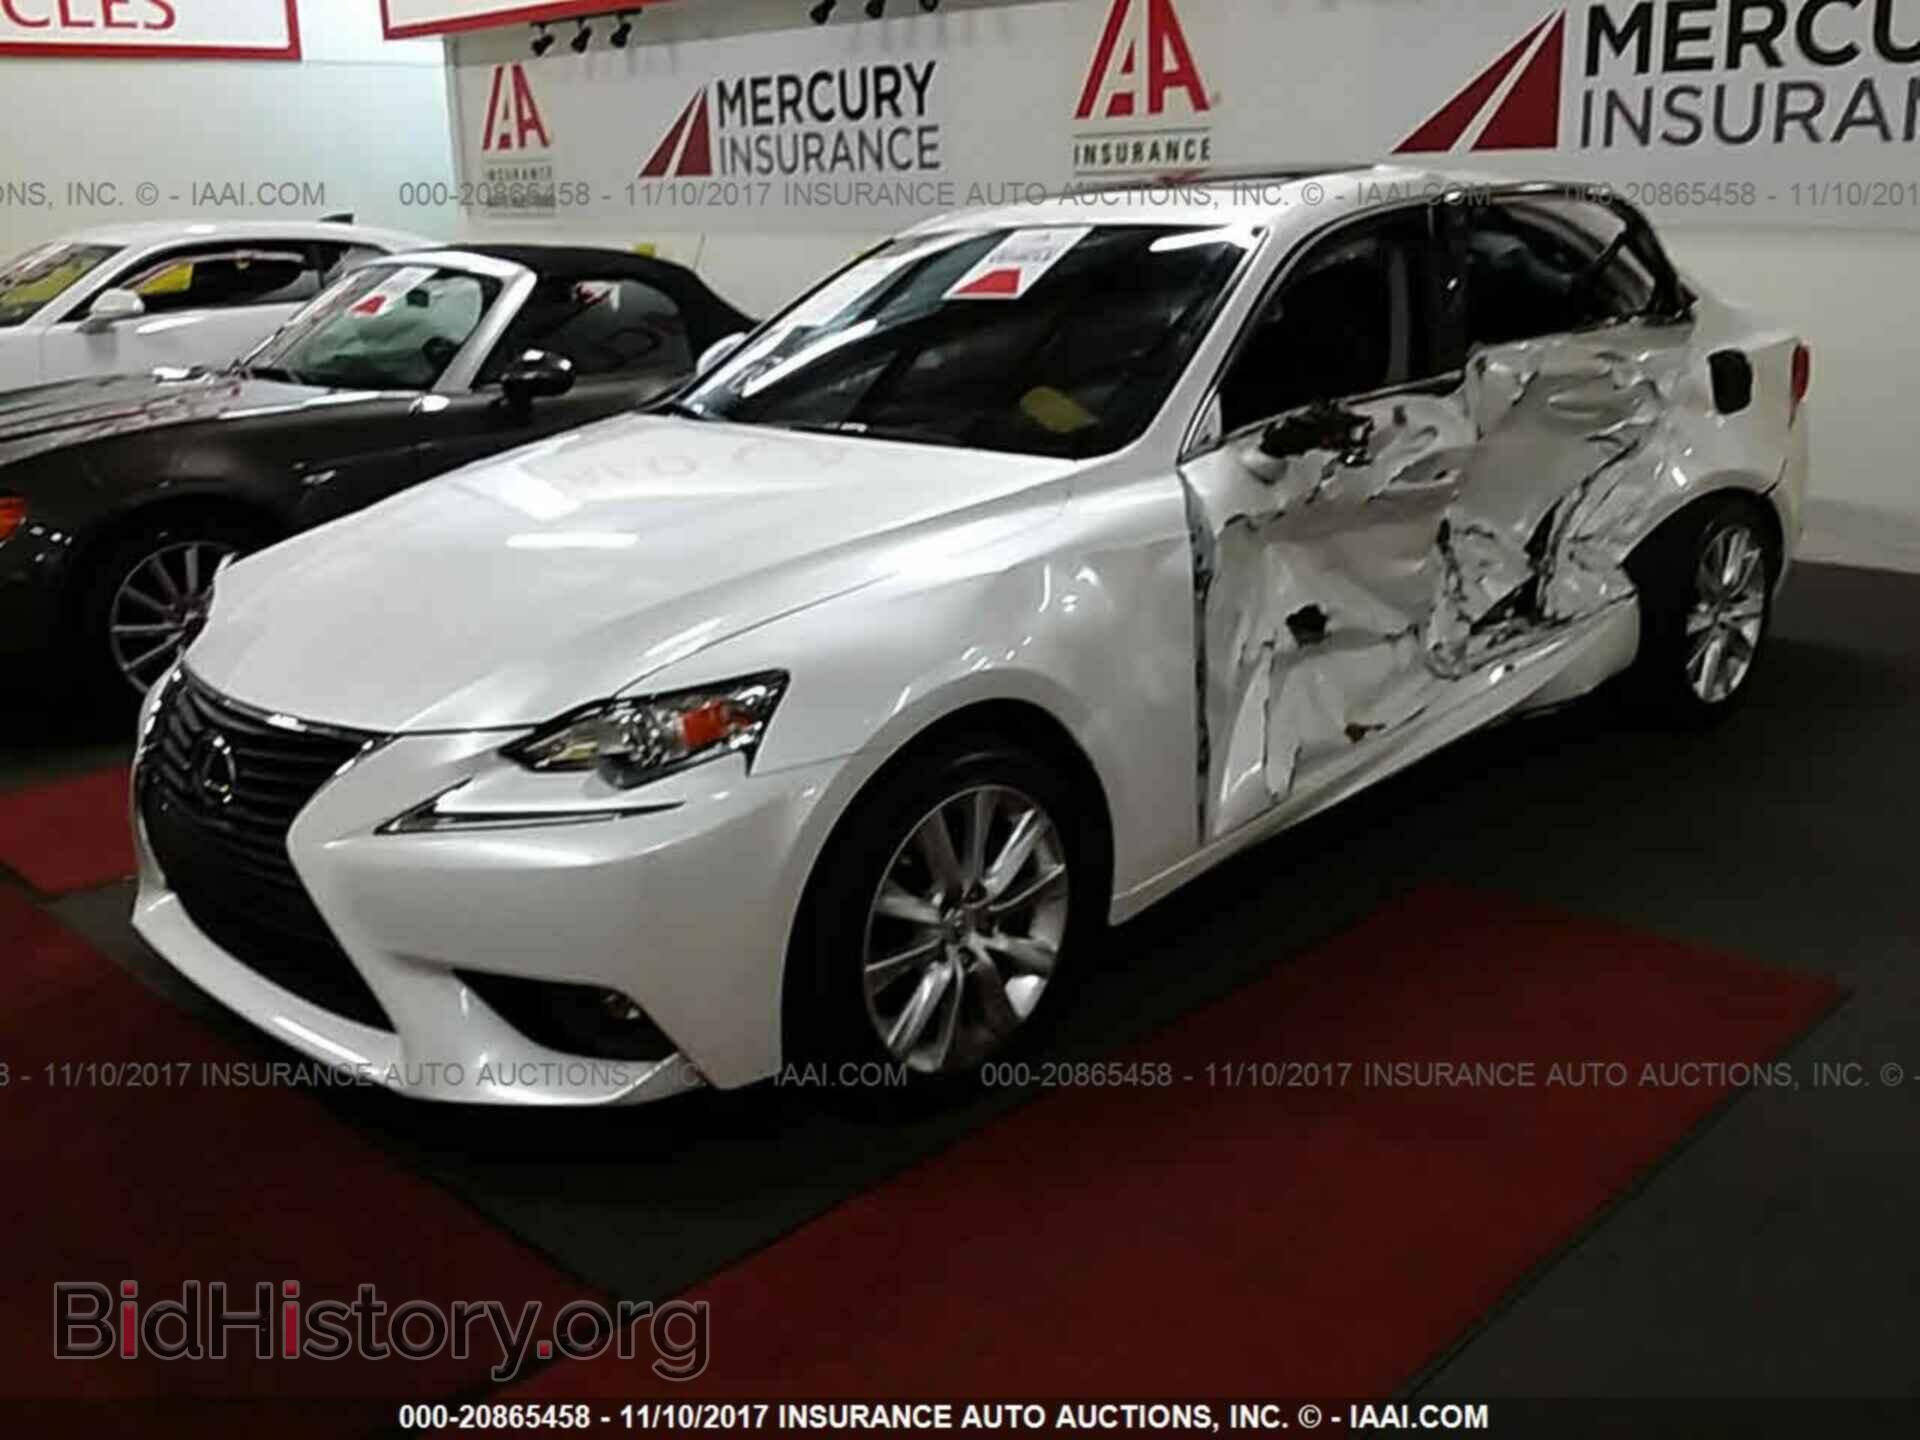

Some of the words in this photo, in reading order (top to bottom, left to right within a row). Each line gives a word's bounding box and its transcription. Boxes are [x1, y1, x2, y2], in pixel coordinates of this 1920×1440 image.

[717, 60, 936, 128] MERCURY
[719, 125, 941, 175] INSURANCE
[1074, 137, 1211, 166] INSURANCE
